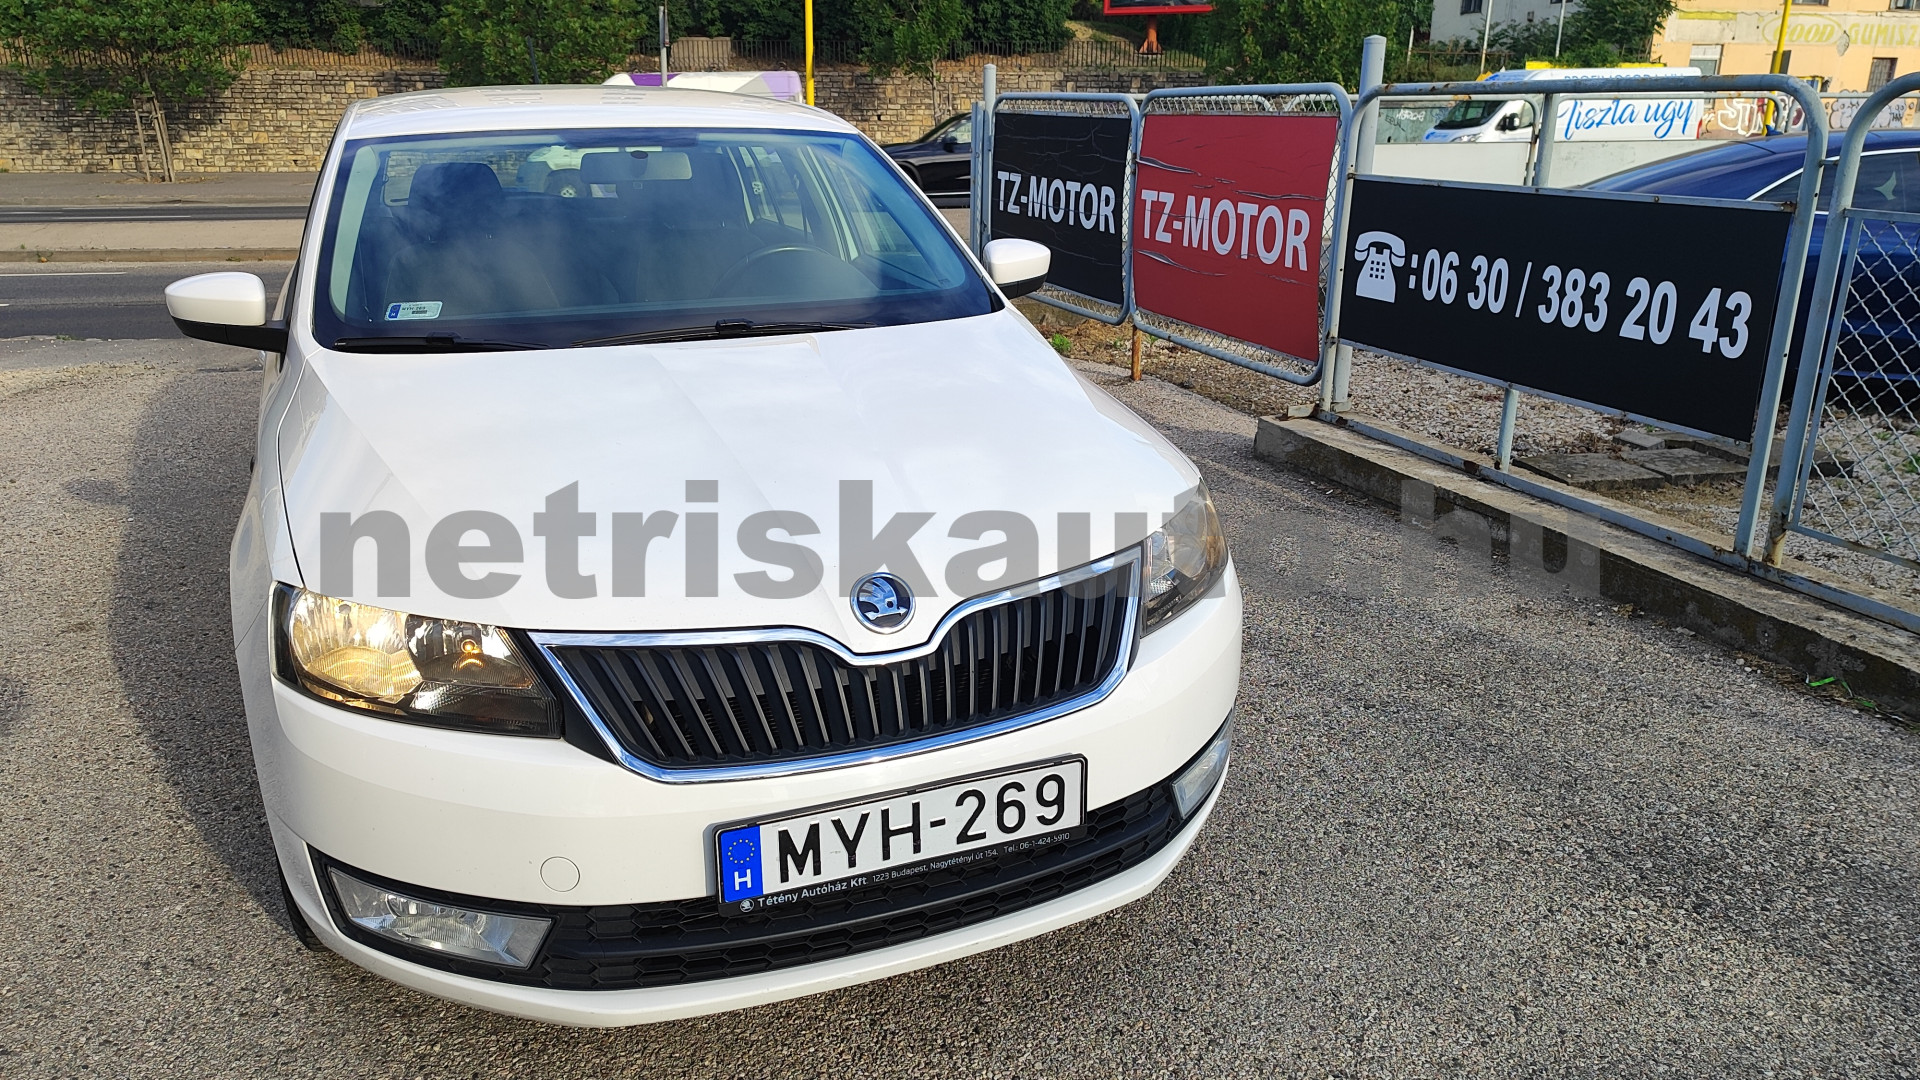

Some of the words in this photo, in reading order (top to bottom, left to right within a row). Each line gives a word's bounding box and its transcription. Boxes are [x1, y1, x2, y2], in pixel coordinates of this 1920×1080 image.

[1848, 23, 1920, 45] GUMISZ
[997, 170, 1116, 234] TZ-MOTOR
[1141, 189, 1310, 271] TZ-MOTOR
[1467, 255, 1509, 313] 30
[1538, 265, 1611, 332] 383
[1619, 277, 1678, 345] 20
[1688, 287, 1752, 359] 43
[777, 773, 1066, 884] MYH-269
[734, 868, 752, 891] H
[757, 891, 799, 908] Tétény
[801, 881, 848, 899] Autóház
[872, 872, 890, 883] 1223
